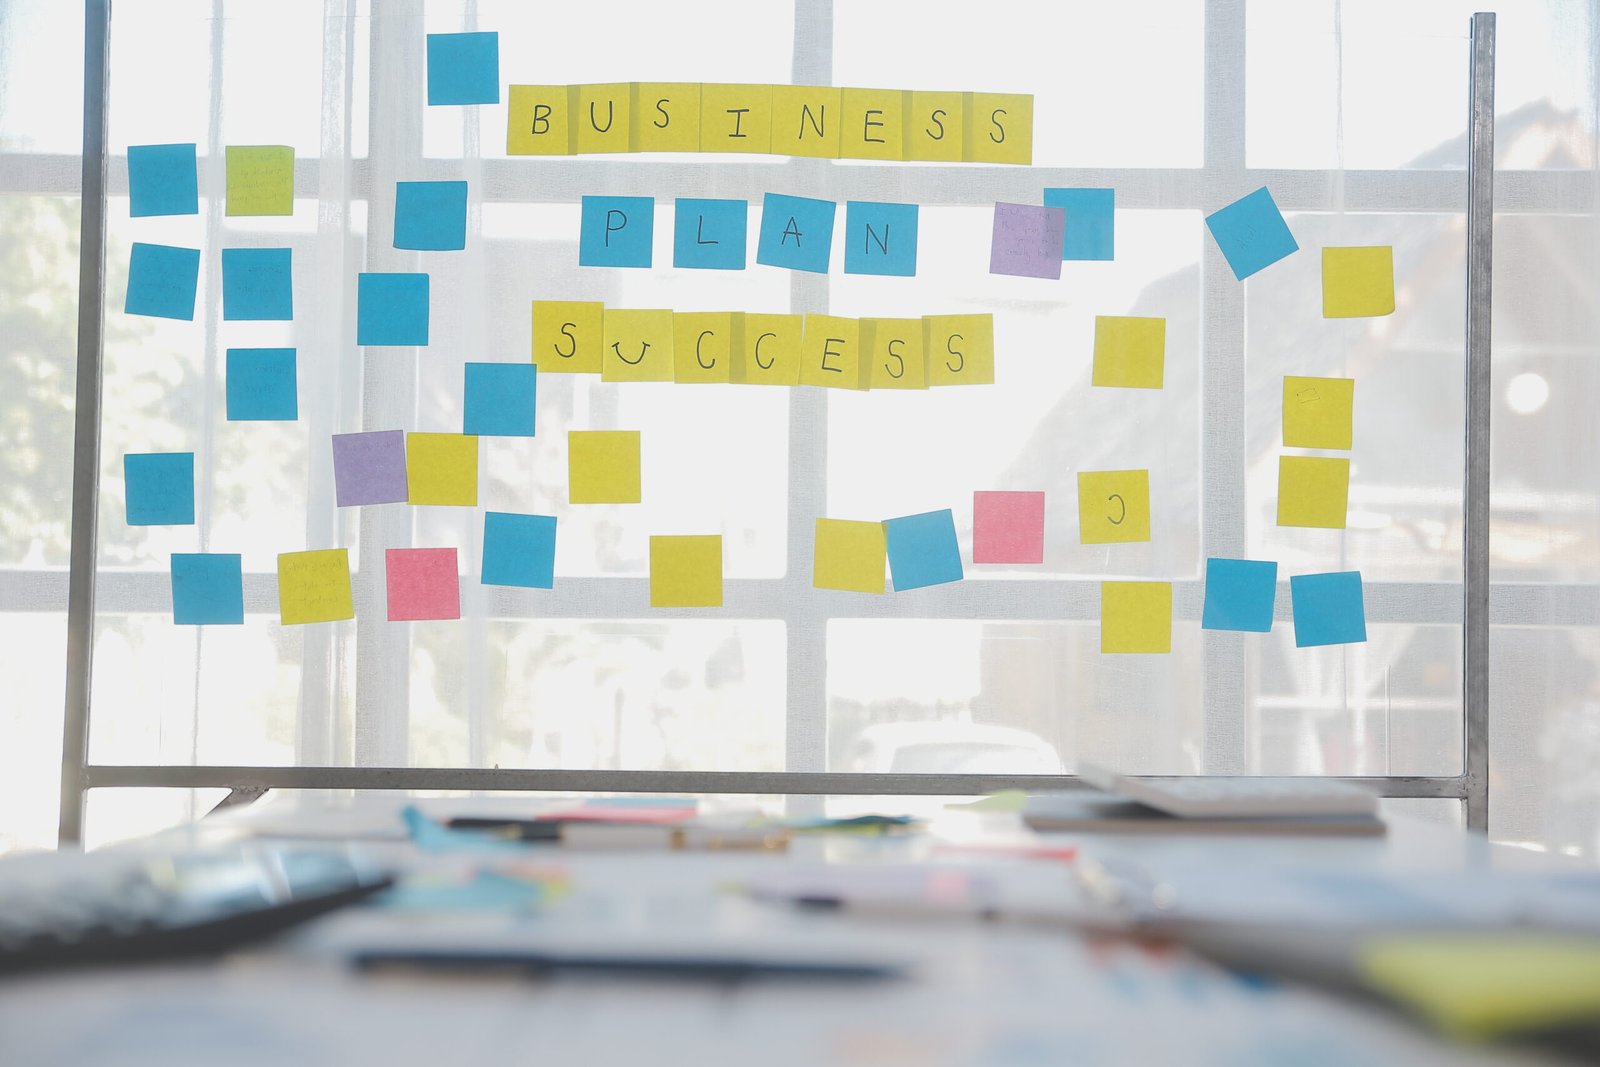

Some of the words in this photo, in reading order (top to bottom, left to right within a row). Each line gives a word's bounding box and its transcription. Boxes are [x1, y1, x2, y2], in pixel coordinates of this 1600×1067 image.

[531, 98, 1007, 144] BUSINESS
[605, 209, 889, 254] PLAN
[554, 322, 964, 378] SUCCESS
